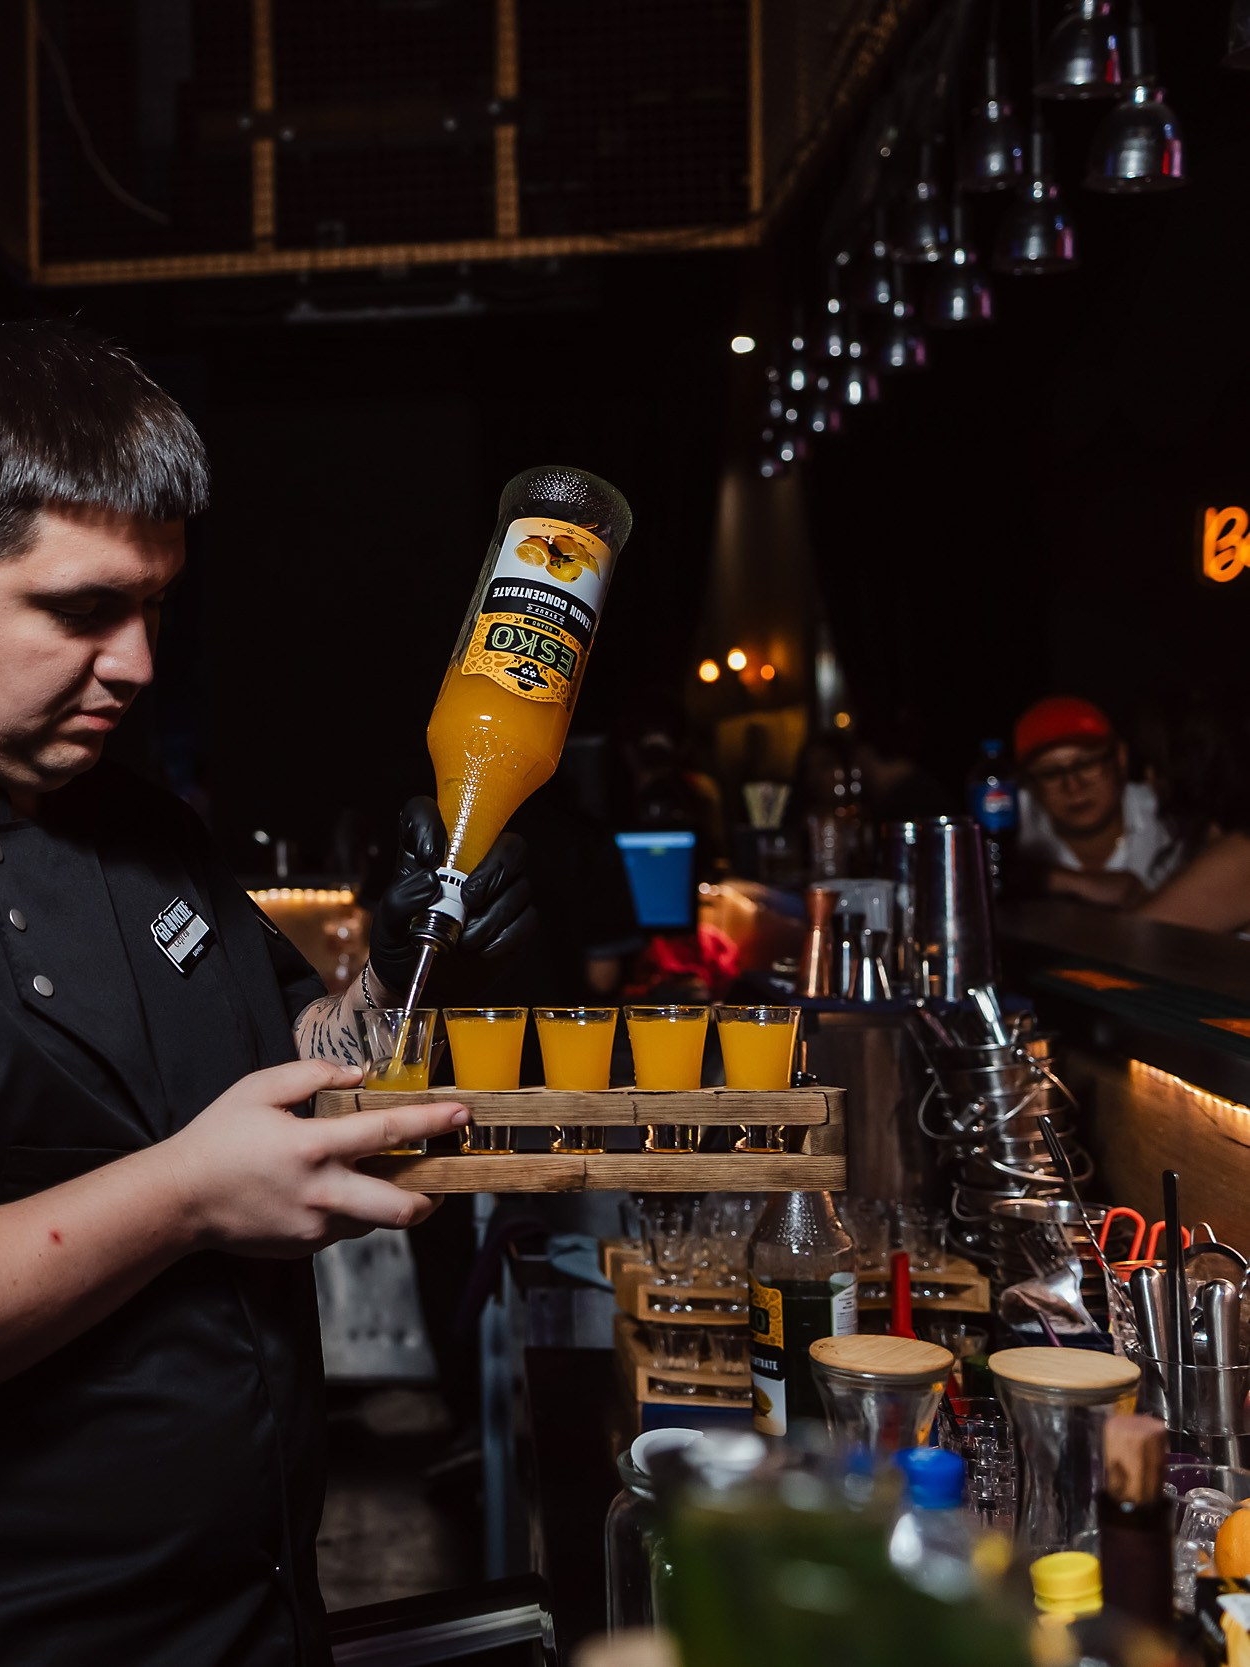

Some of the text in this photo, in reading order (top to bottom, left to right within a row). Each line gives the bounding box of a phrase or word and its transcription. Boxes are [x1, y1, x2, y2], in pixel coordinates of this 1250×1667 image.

[492, 586, 592, 633] LEMON CONCENTRATE
[534, 606, 558, 620] SYRUP
[491, 626, 575, 678] ESKO
